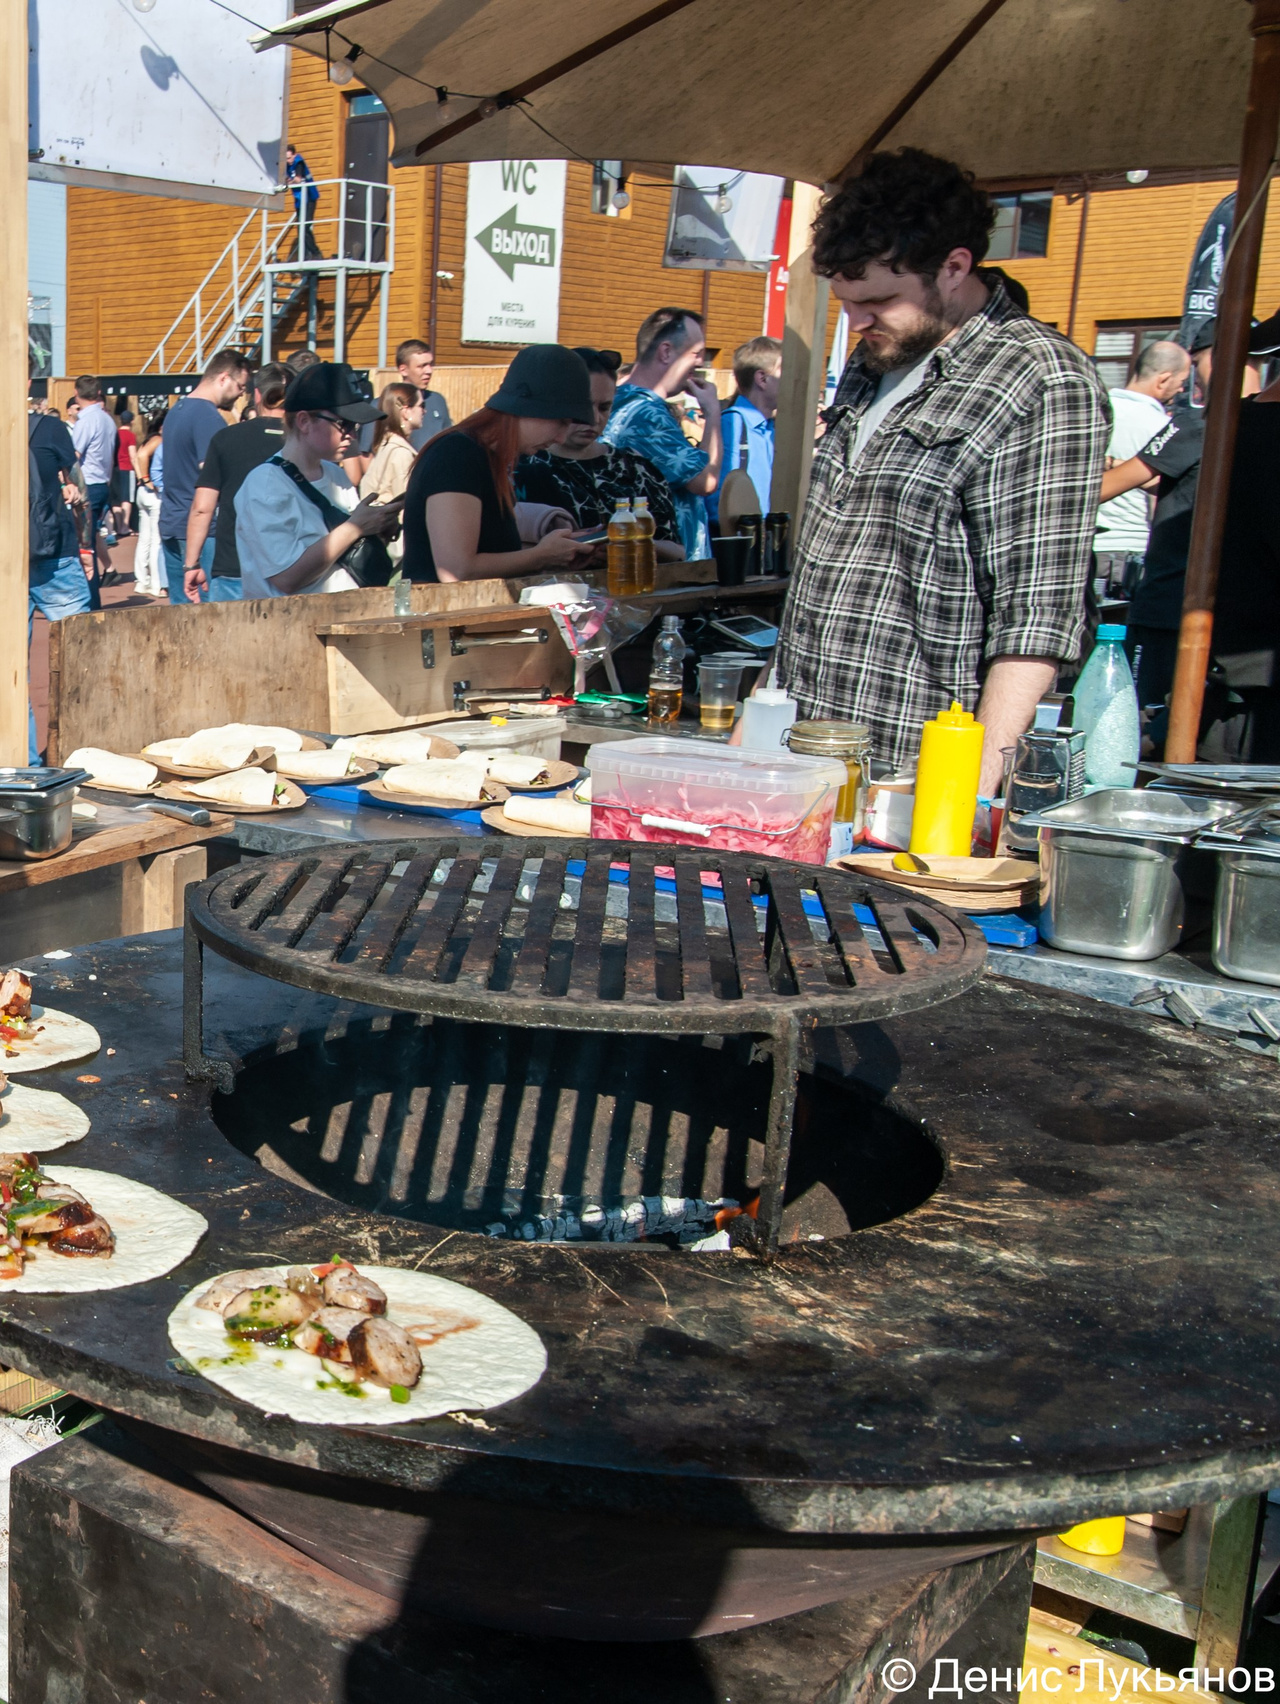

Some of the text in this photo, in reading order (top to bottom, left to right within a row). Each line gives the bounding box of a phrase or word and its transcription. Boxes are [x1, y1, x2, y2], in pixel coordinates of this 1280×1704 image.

[501, 161, 538, 195] WC
[491, 228, 550, 264] ВЫХОД
[501, 302, 524, 312] МЕСТА
[1188, 294, 1216, 311] BIG
[487, 316, 535, 329] ДЛЯ КУРЕНИЯ
